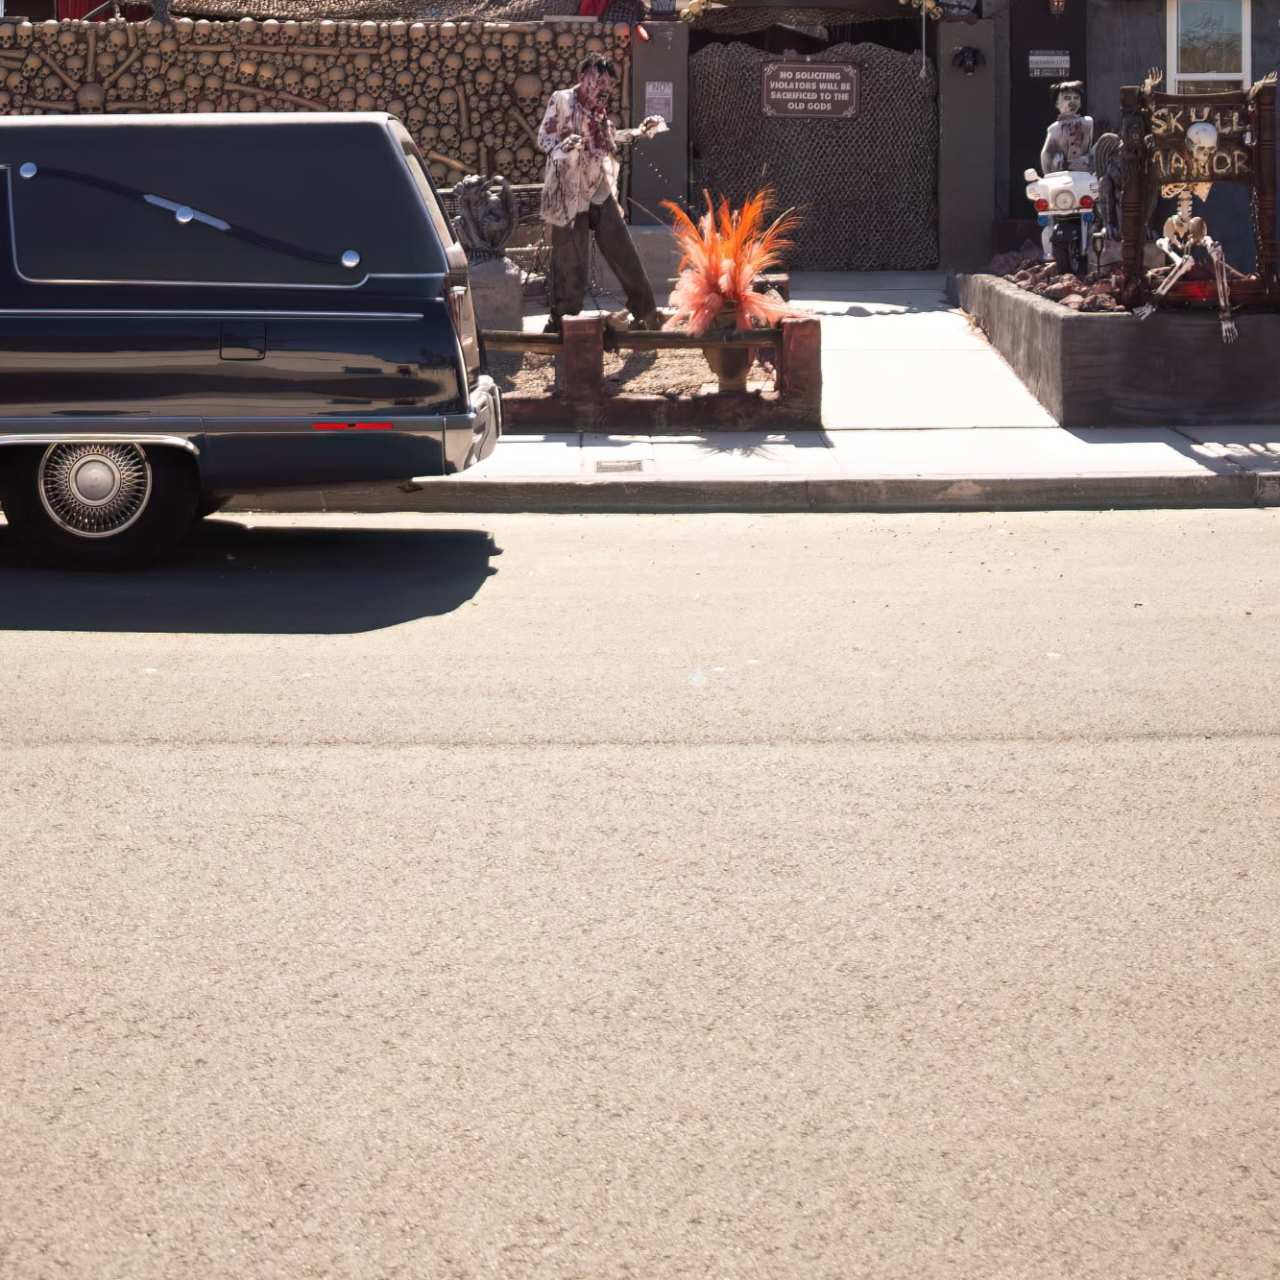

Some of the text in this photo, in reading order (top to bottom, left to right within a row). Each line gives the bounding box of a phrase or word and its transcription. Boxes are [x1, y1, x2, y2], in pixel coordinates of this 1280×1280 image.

[780, 71, 841, 80] NO SOLICITING
[769, 81, 851, 90] VIOLATORS WILL BE
[770, 91, 849, 100] SACRIFICED TO THE
[787, 102, 832, 110] OLD GODS
[1151, 107, 1250, 134] SKULL
[1148, 150, 1249, 177] MAOR
